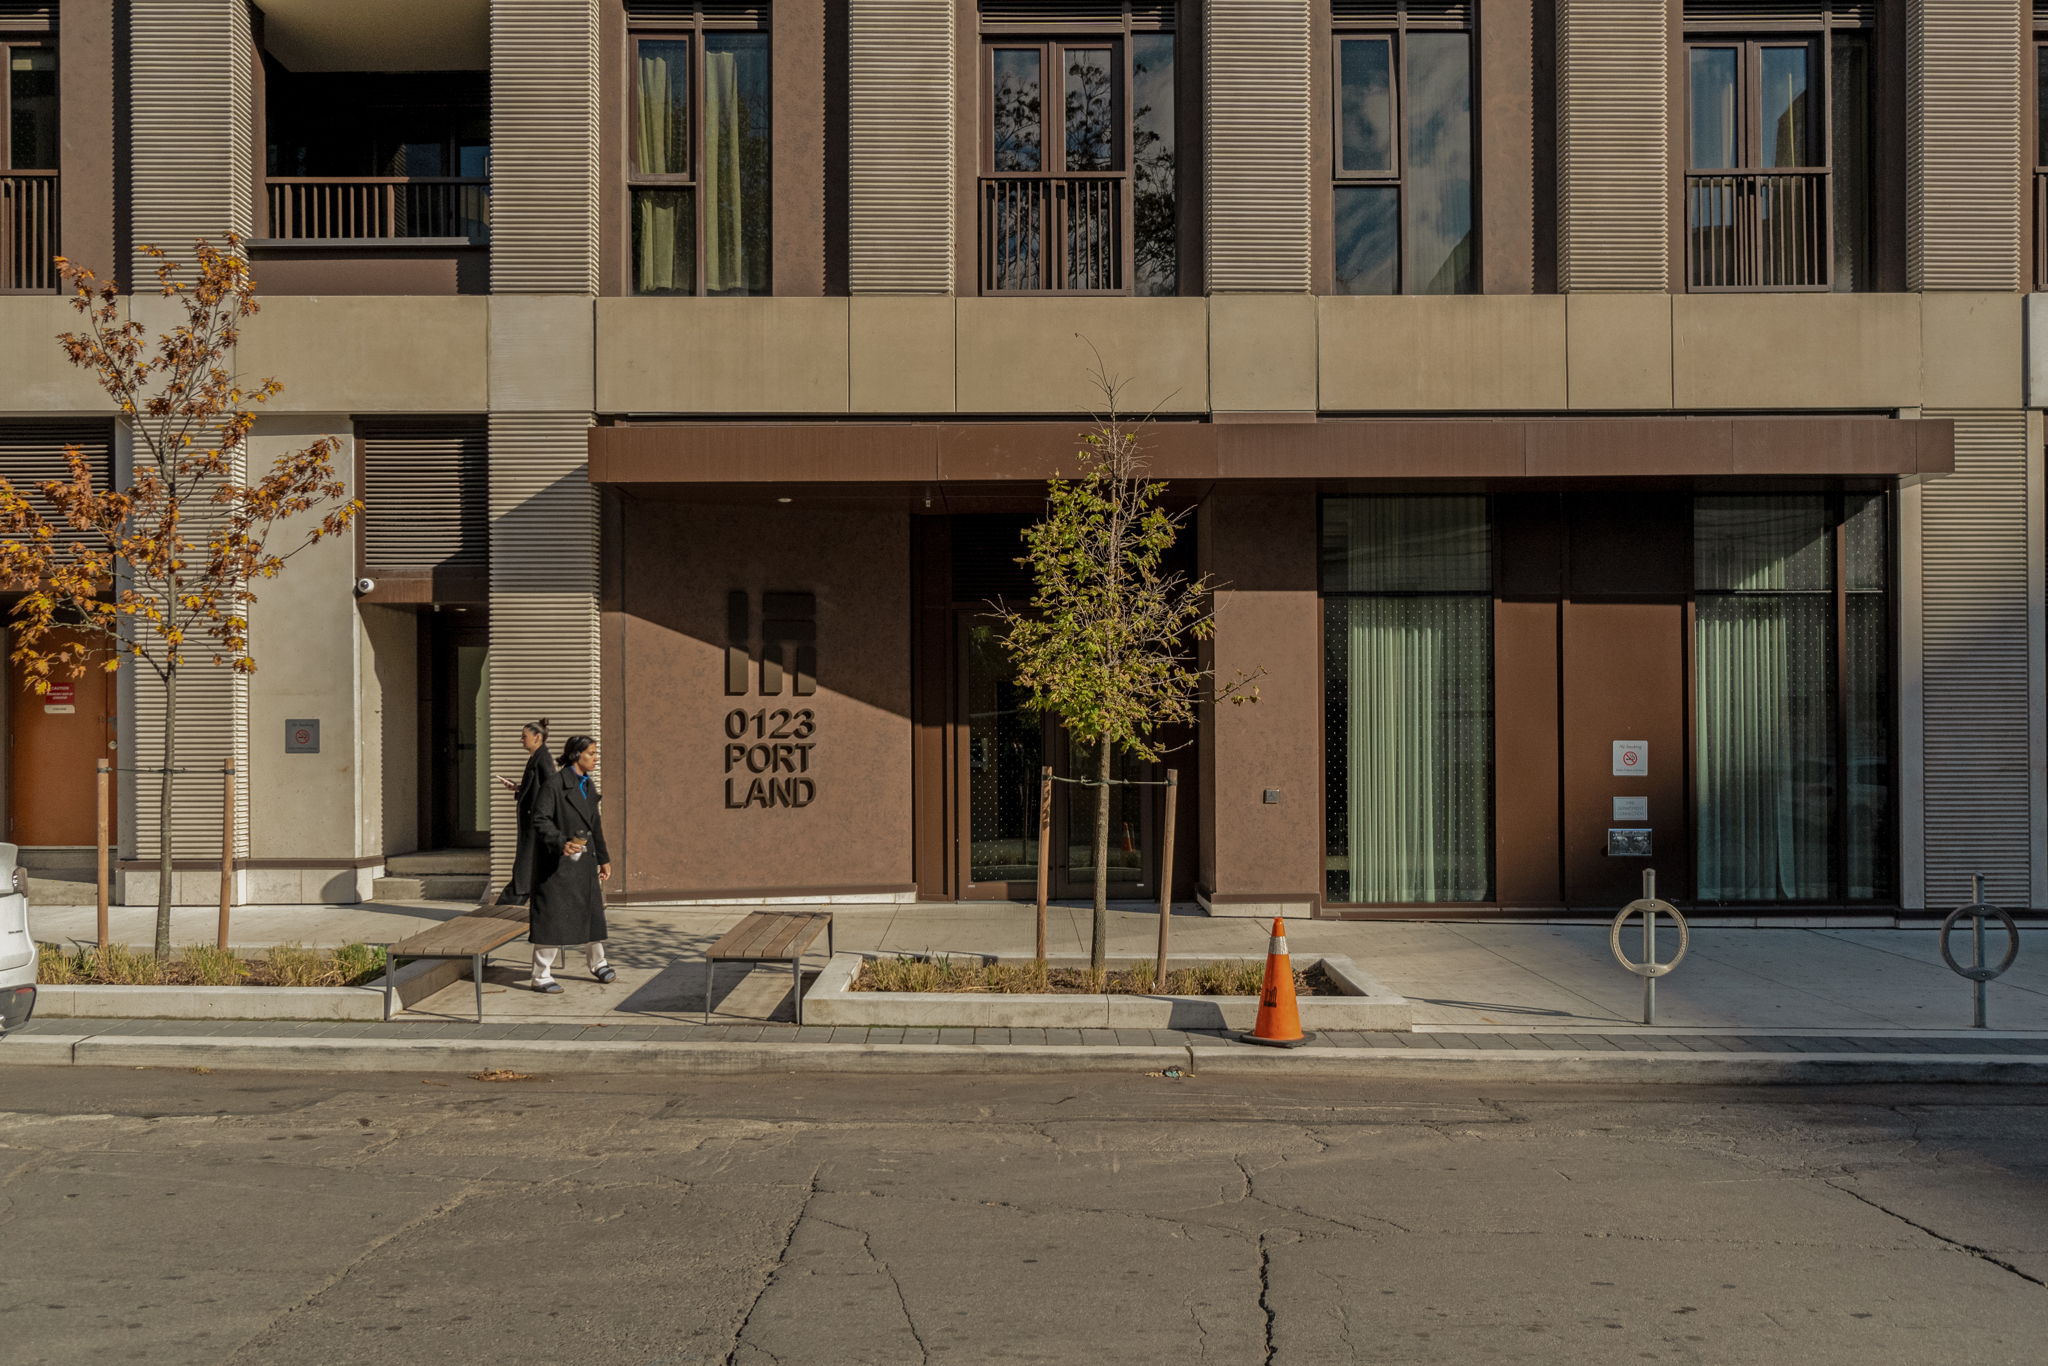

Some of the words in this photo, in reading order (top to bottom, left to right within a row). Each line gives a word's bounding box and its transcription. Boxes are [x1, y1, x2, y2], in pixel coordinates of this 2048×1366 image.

[724, 707, 817, 740] 0123
[724, 742, 817, 775] PORT
[724, 776, 817, 810] LAND
